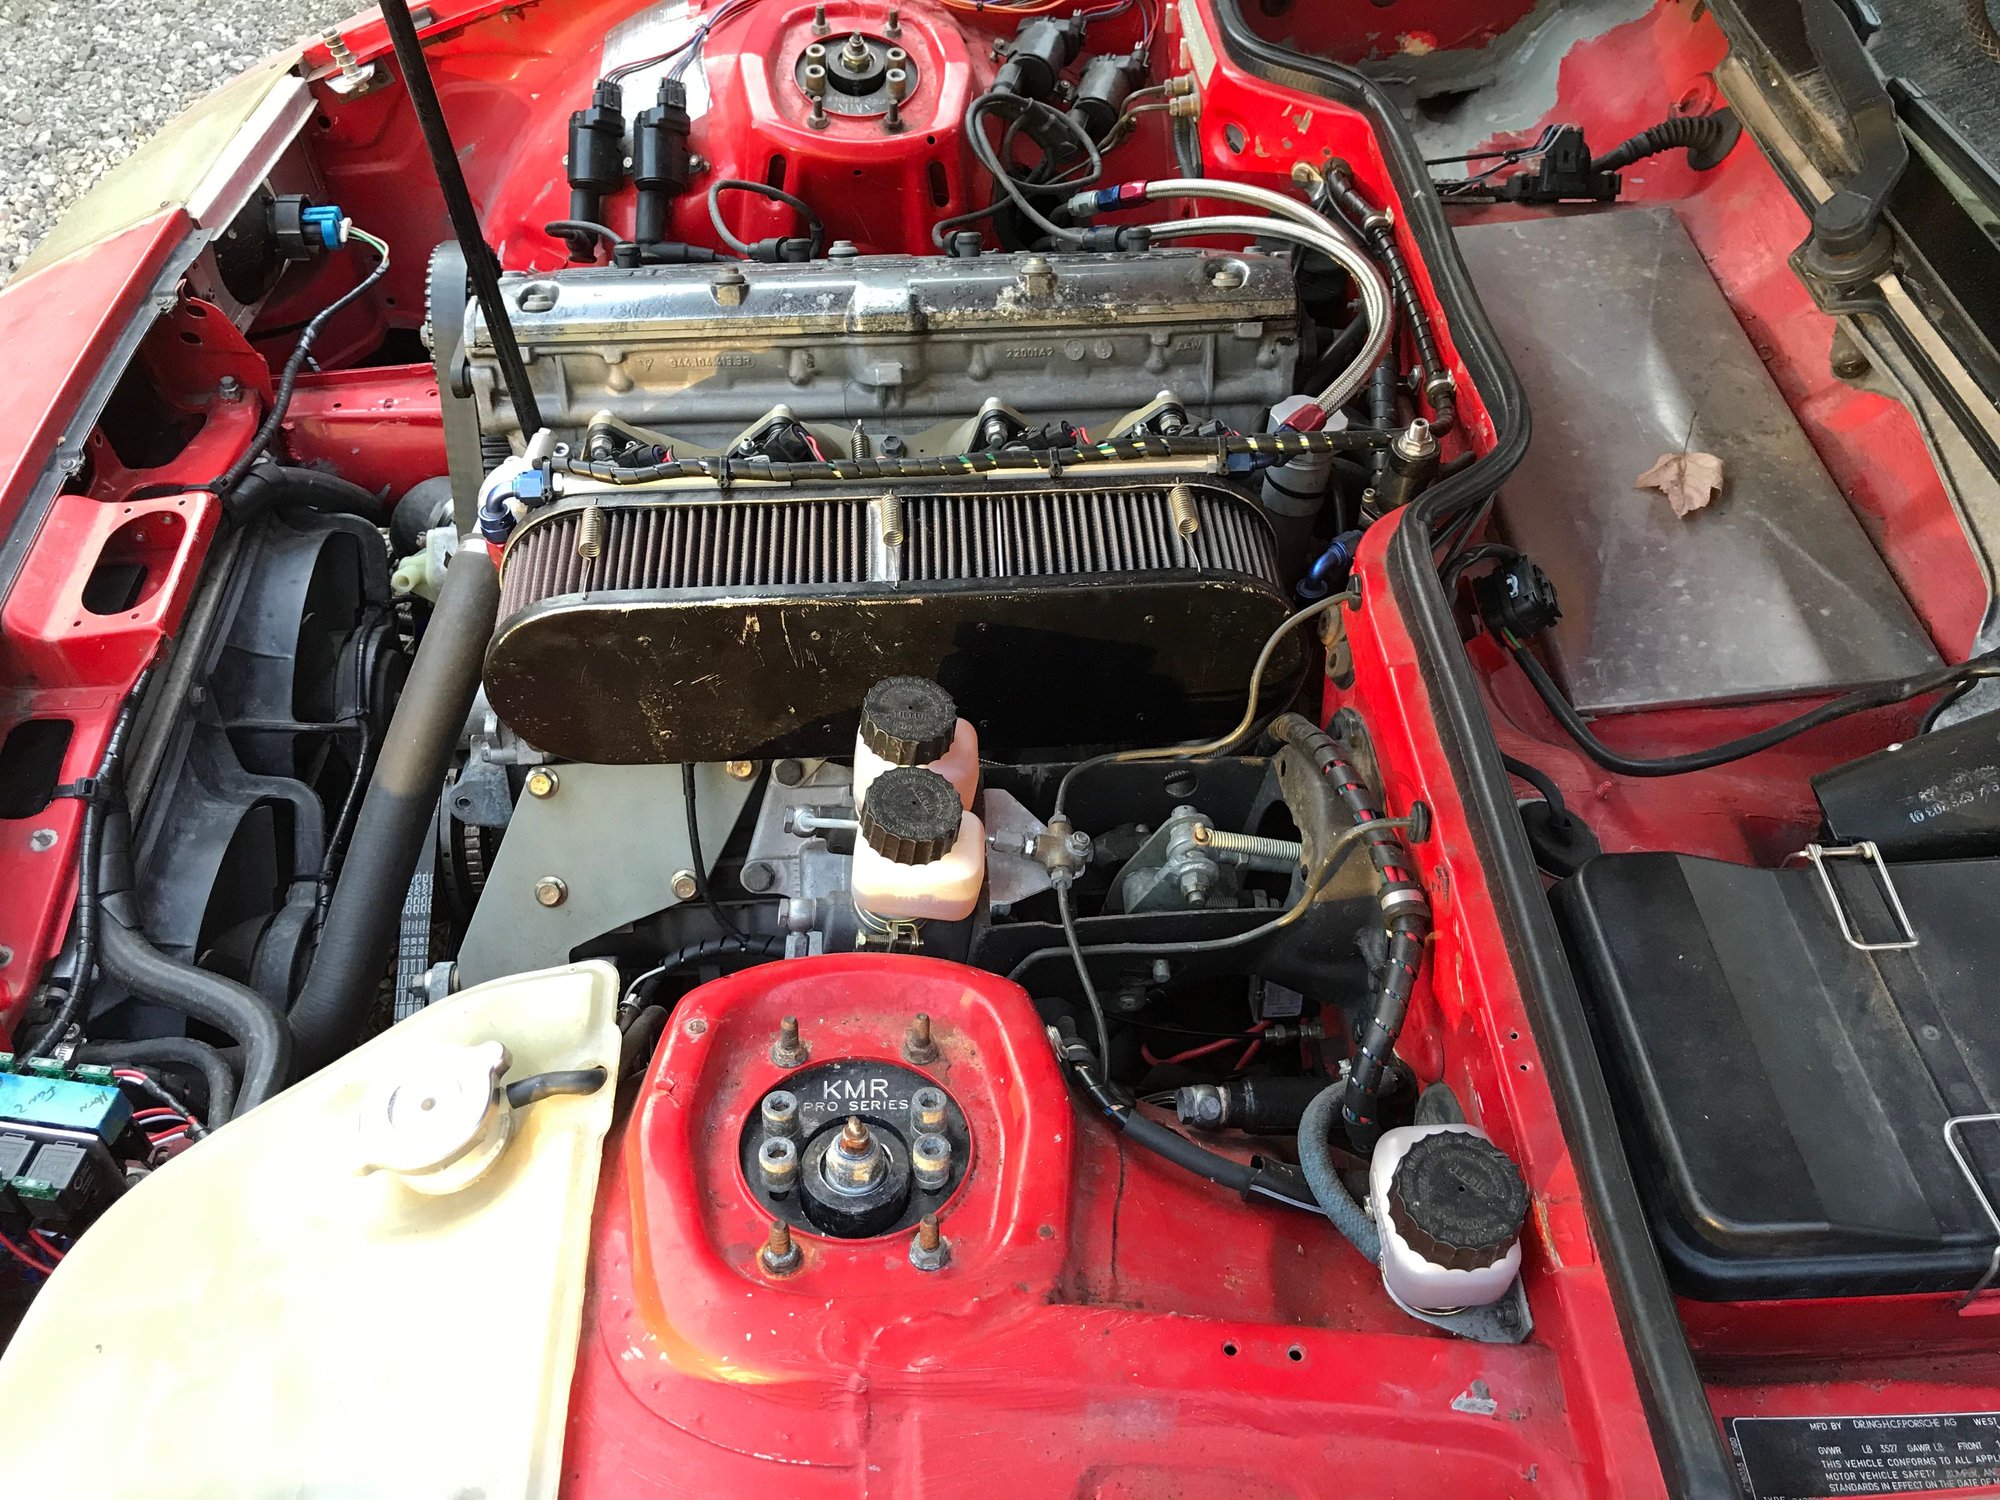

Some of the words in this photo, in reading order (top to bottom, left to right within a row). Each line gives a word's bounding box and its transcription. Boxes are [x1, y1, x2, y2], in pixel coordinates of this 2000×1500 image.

[413, 871, 422, 917] DAYCO
[420, 871, 430, 917] DAYCO
[823, 1079, 888, 1099] KMR
[803, 1101, 839, 1112] PRO
[849, 1099, 909, 1111] SERIES
[1809, 1422, 1828, 1431] MFD
[1830, 1421, 1841, 1430] BY
[1944, 1417, 1957, 1427] AG
[1973, 1416, 1997, 1426] WEST
[1818, 1446, 1842, 1455] GVWR
[1861, 1444, 1873, 1454] LB
[1880, 1443, 1898, 1453] 3527
[1906, 1443, 1931, 1452] GAWR
[1957, 1441, 1982, 1450] FRONT
[1821, 1460, 1842, 1469] THIS
[1844, 1458, 1884, 1468] VEHICLE
[1887, 1456, 1937, 1467] CONFORMS
[1939, 1456, 1951, 1465] TO
[1955, 1455, 1972, 1464] ALL
[1825, 1472, 1857, 1481] MOTOR
[1860, 1470, 1899, 1480] VEHICLE
[1902, 1469, 1936, 1479] SAFETY
[1829, 1482, 1880, 1492] STANDARDS
[1881, 1482, 1891, 1491] IN
[1892, 1481, 1923, 1490] EFFECT
[1925, 1480, 1938, 1489] ON
[1939, 1479, 1956, 1488] THE
[1957, 1478, 1979, 1488] DATE
[1981, 1478, 1991, 1486] OF
